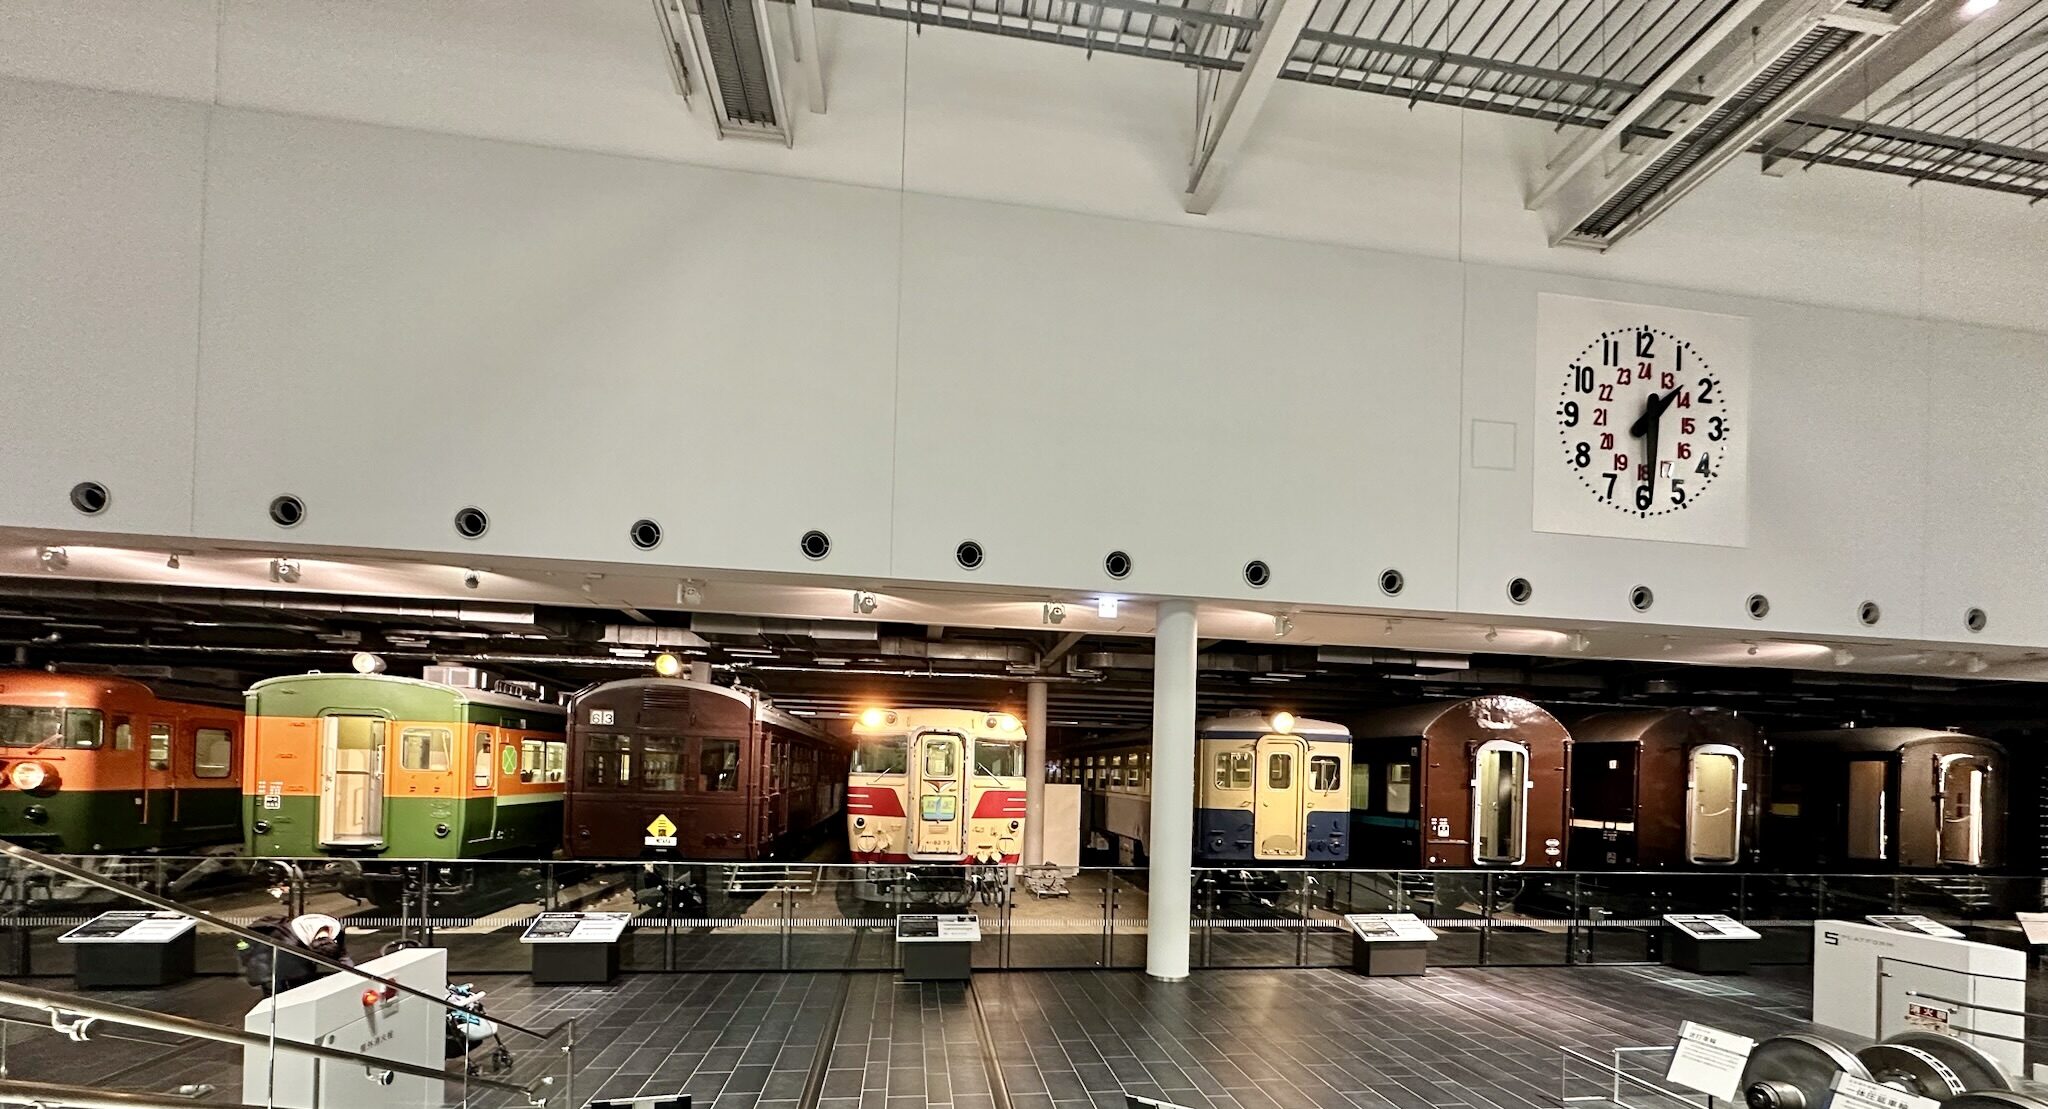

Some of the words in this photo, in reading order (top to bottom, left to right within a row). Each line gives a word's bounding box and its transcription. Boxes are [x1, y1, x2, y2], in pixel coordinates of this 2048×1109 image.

[1604, 340, 1618, 366] 11
[1637, 332, 1654, 358] 12
[1676, 345, 1682, 371] 1
[1575, 366, 1593, 393] 10
[1617, 369, 1631, 385] 23
[1638, 363, 1652, 379] 24
[1661, 372, 1674, 389] 13
[1599, 384, 1613, 401] 22
[1698, 378, 1712, 403] 2
[1677, 392, 1690, 408] 14
[1564, 401, 1579, 427] 9
[1594, 409, 1607, 426] 21
[1682, 418, 1695, 434] 15
[1708, 416, 1723, 441] 3
[1600, 433, 1613, 449] 20
[1576, 442, 1591, 467] 8
[1678, 442, 1691, 459] 16
[1614, 454, 1628, 470] 19
[1660, 461, 1674, 478] 17
[1695, 452, 1710, 477] 4
[1603, 473, 1617, 499] 7
[1671, 479, 1685, 504] 5
[1636, 485, 1651, 510] 6
[592, 713, 613, 724] 63
[1824, 931, 1839, 946] S
